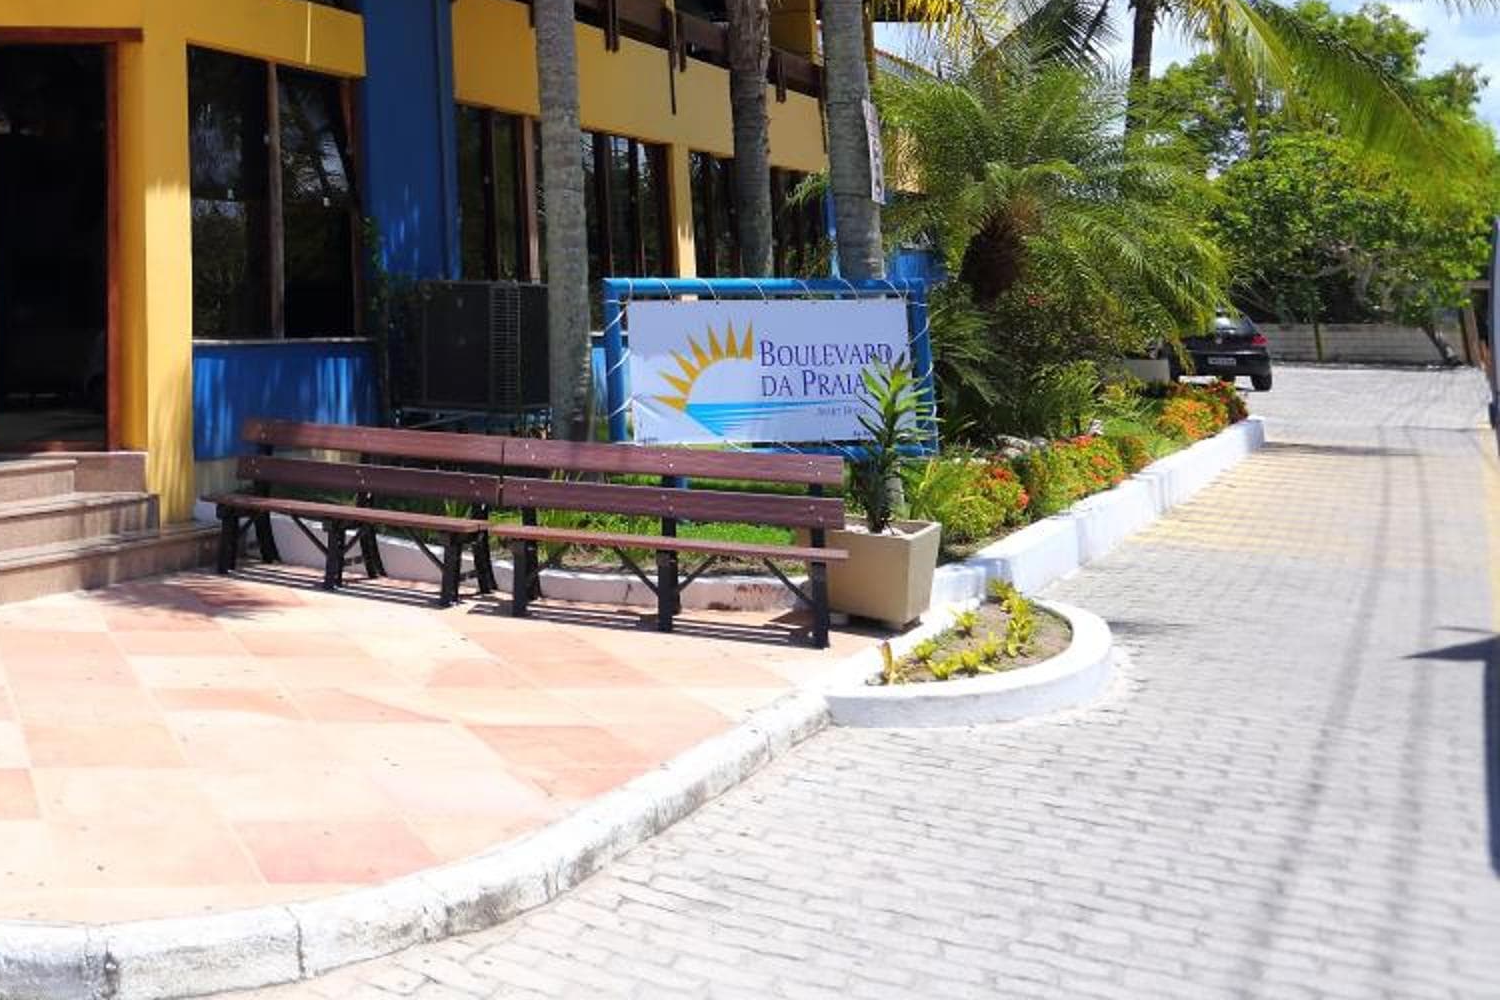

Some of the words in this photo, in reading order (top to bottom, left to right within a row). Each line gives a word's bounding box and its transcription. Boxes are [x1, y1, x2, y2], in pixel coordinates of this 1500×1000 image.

[760, 340, 893, 366] BOULEVARD
[761, 375, 793, 397] DA
[802, 369, 869, 396] PRAIA
